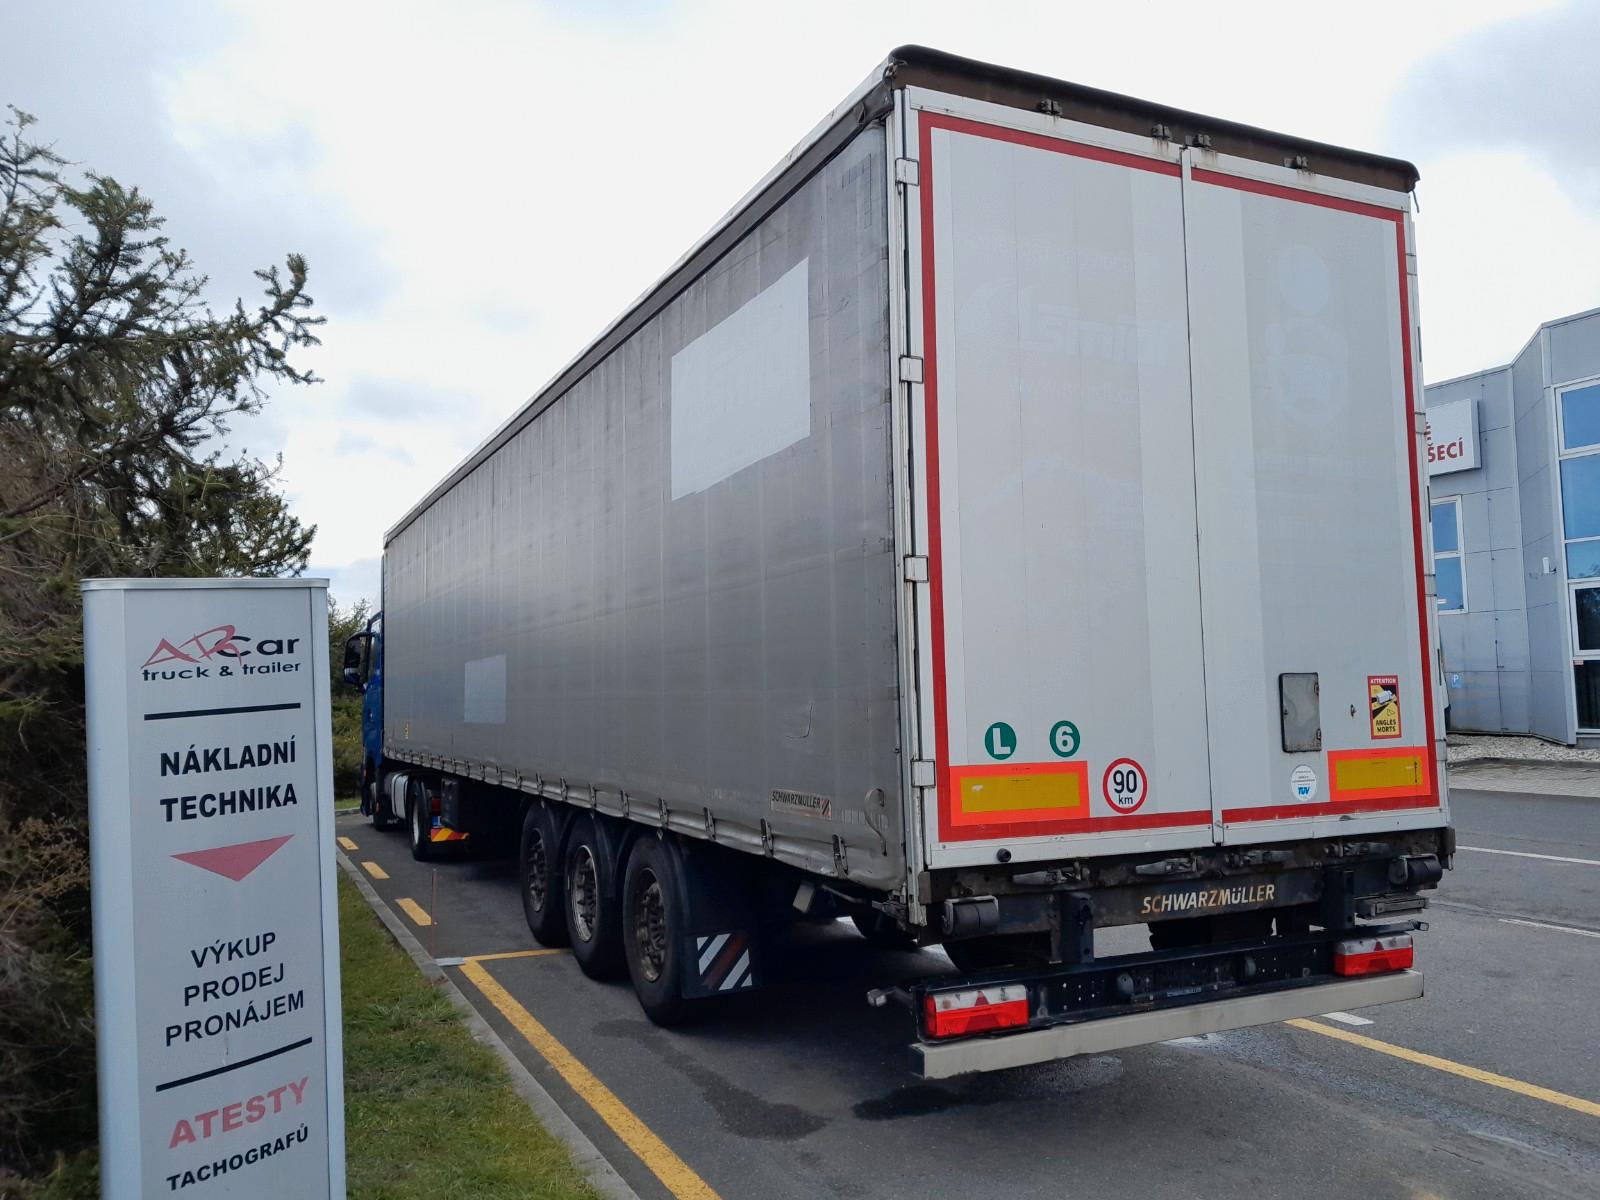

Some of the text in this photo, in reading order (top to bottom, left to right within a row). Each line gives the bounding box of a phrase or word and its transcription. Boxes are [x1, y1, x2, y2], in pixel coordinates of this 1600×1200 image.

[142, 661, 301, 681] truck & trailer
[160, 734, 296, 777] NÁKLADNÍ
[992, 727, 1011, 755] L
[1055, 725, 1075, 753] 6
[1113, 769, 1138, 794] 90
[1118, 794, 1134, 805] km
[159, 783, 298, 822] TECHNIKA
[190, 932, 276, 969] VÝKUP
[183, 962, 285, 1007] PRODEJ
[165, 990, 304, 1047] PRONÁJEM
[168, 1076, 309, 1149] ATESTY
[166, 1122, 309, 1191] TACHOGRAFŮ
